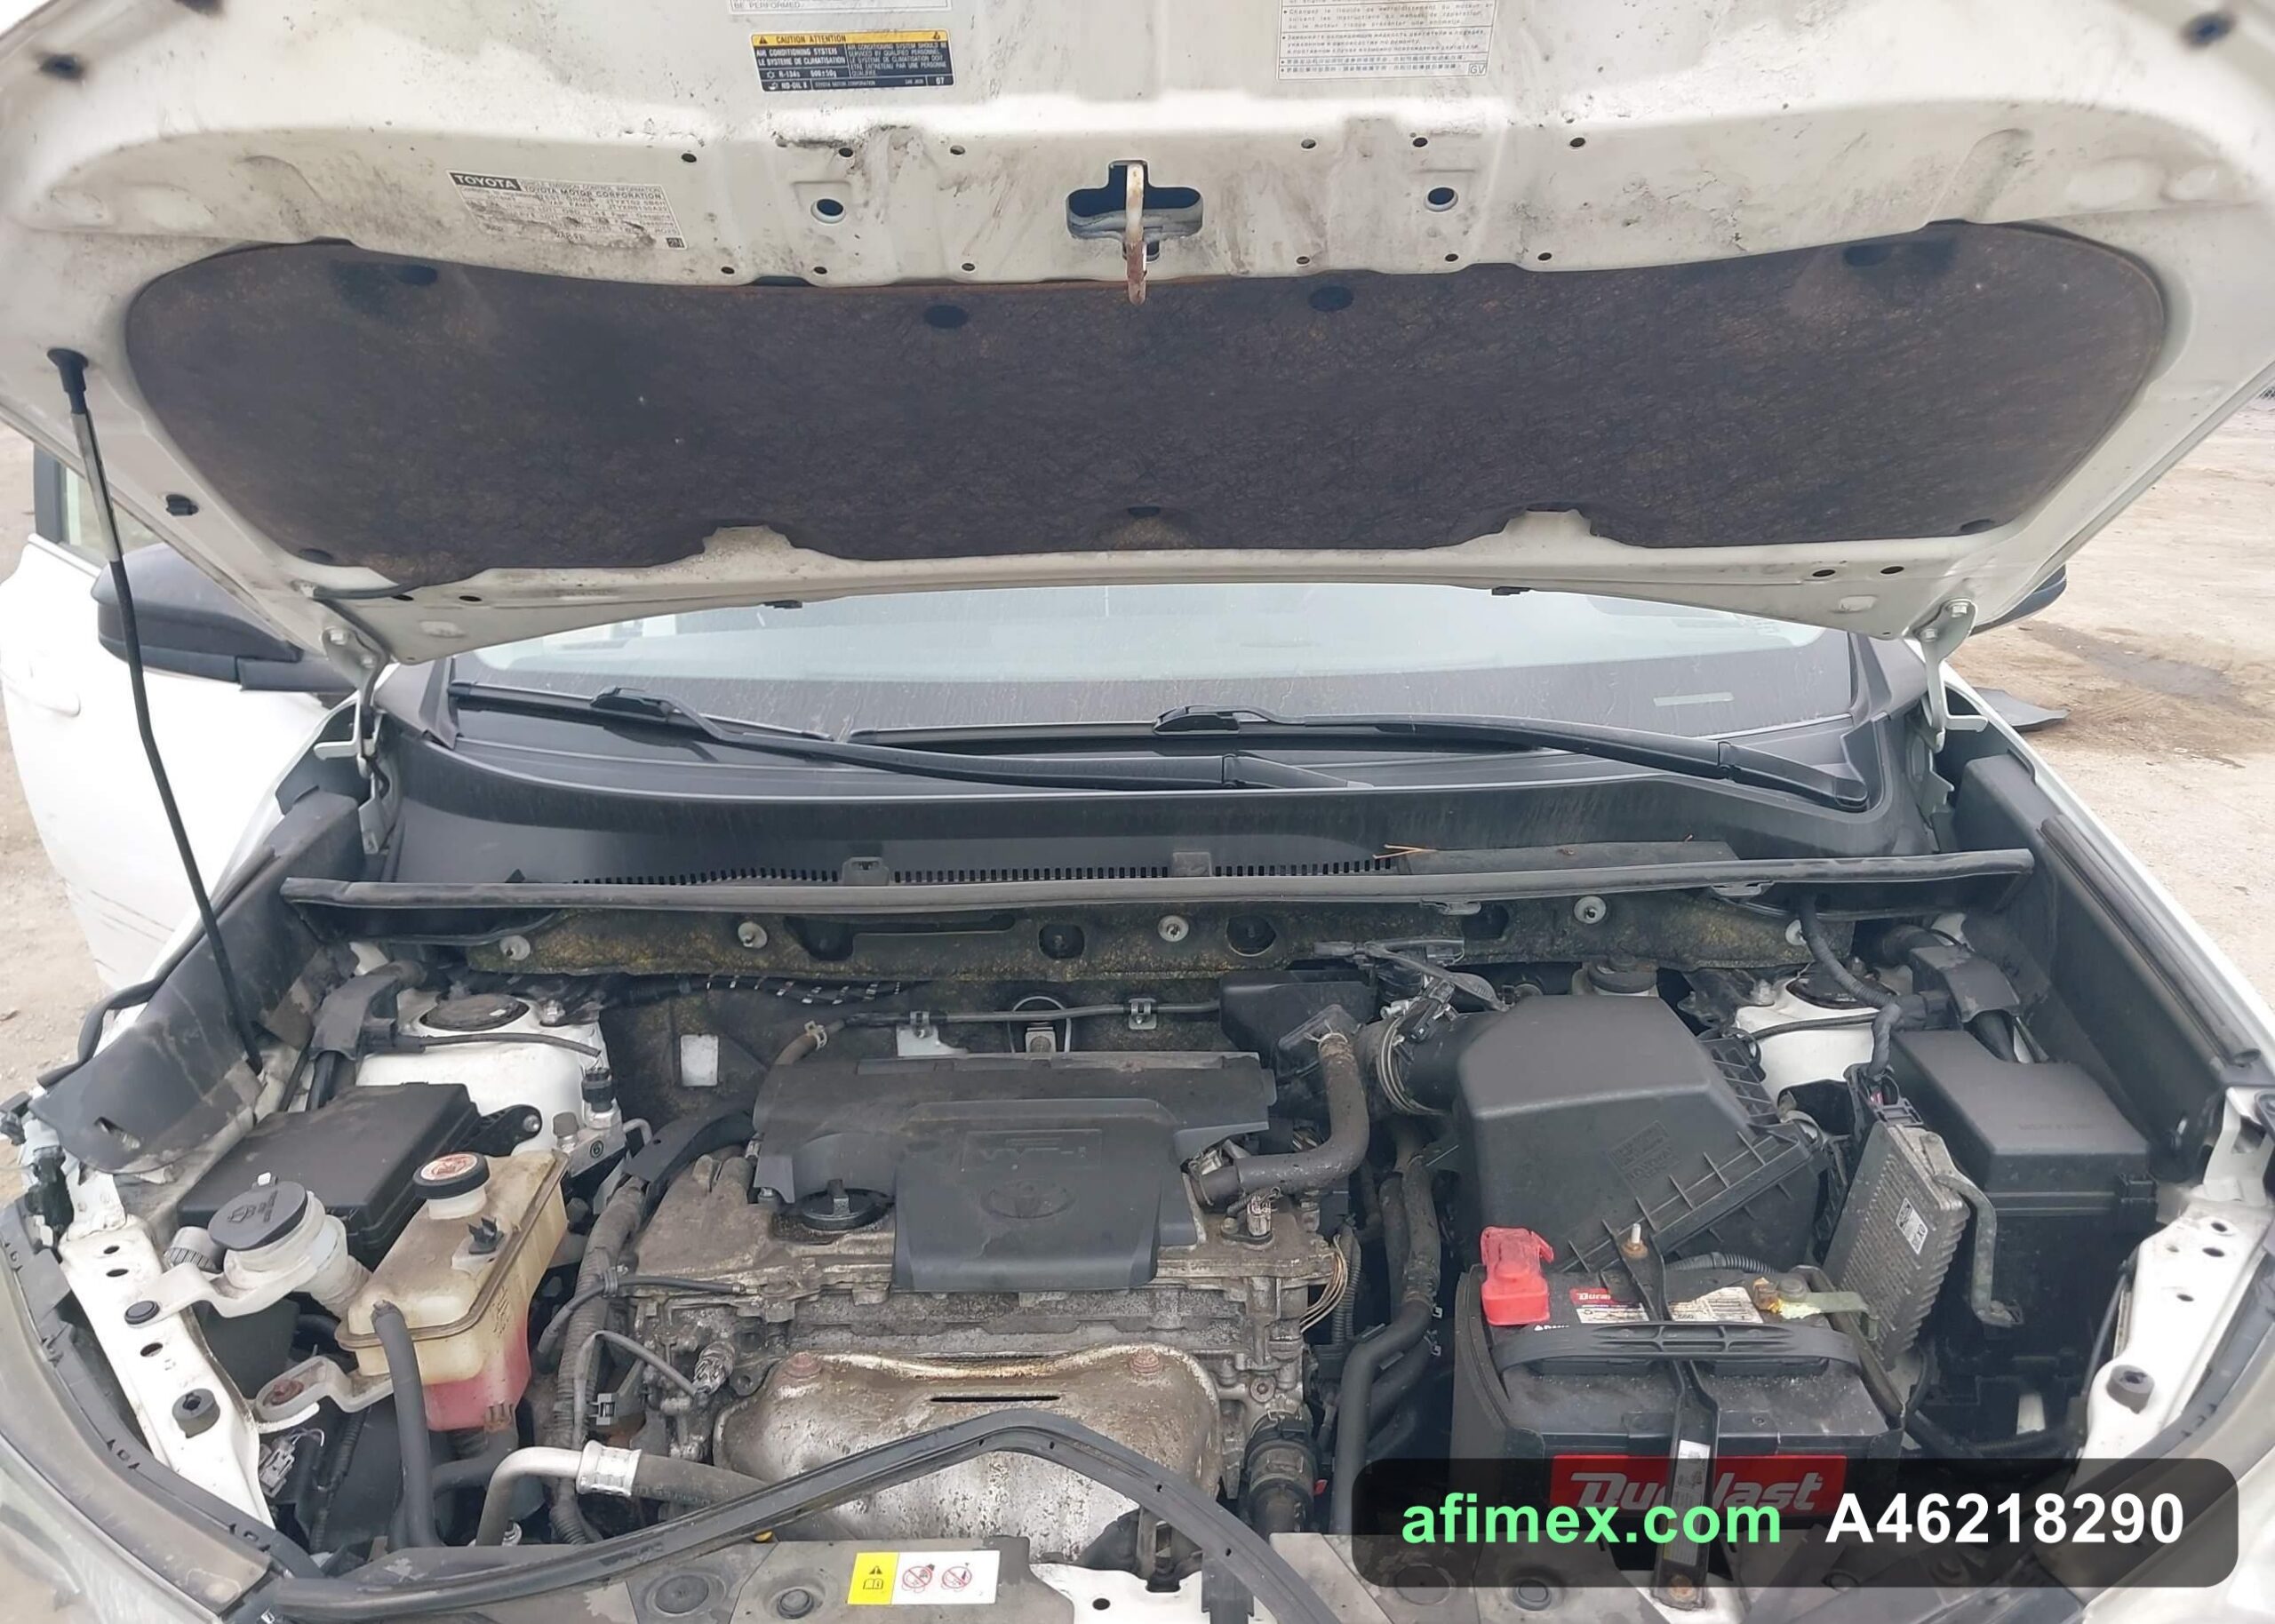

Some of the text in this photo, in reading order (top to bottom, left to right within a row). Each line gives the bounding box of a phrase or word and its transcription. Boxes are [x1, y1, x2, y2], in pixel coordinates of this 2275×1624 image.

[810, 35, 847, 44] ATTENTION
[769, 48, 810, 57] CONDITIONING
[455, 174, 517, 188] TOYOTA
[525, 185, 558, 194] TOYOTA
[561, 187, 593, 197] MOTOR
[595, 190, 661, 200] CORPORATION
